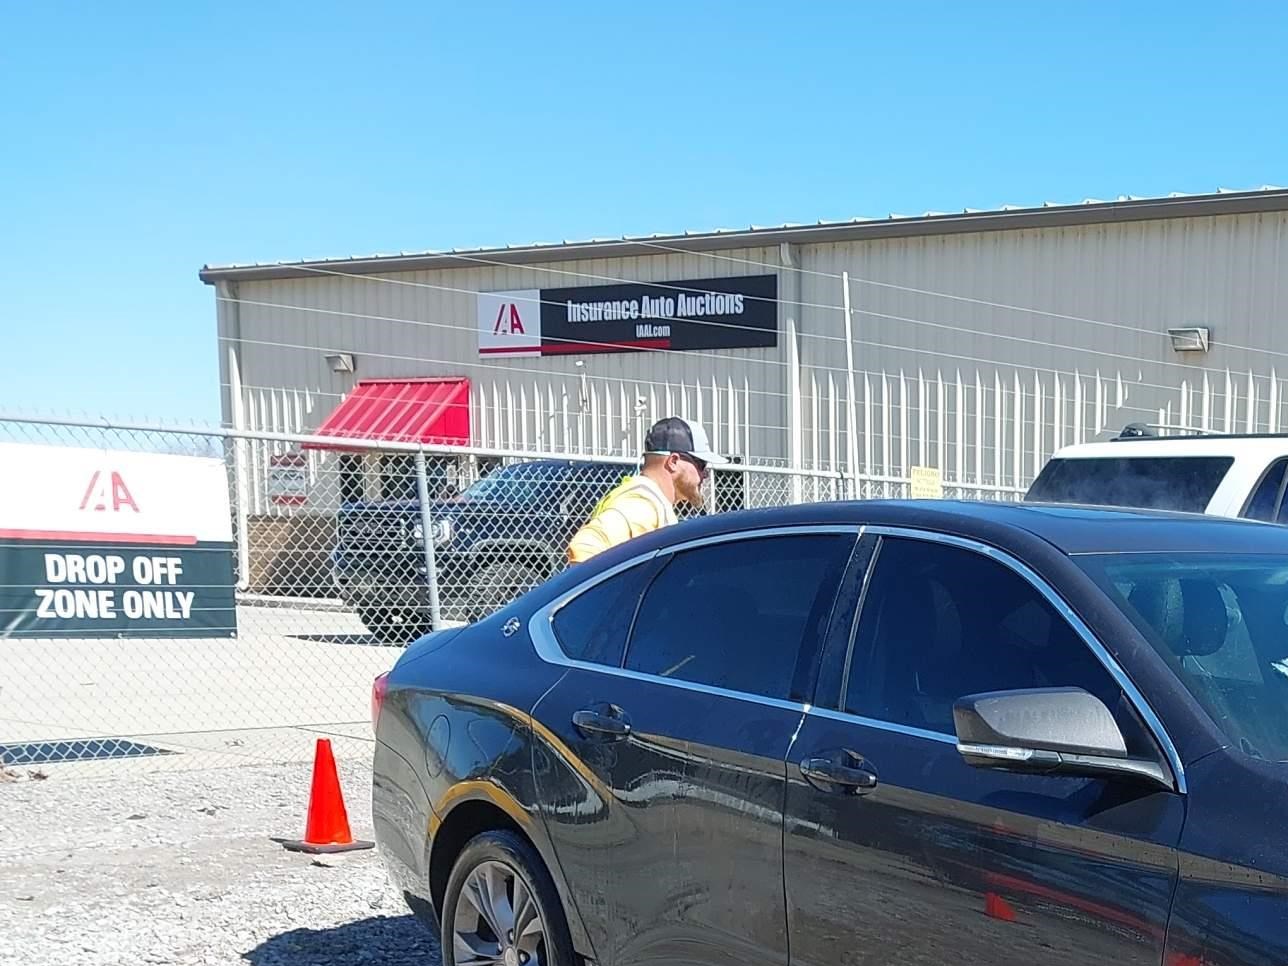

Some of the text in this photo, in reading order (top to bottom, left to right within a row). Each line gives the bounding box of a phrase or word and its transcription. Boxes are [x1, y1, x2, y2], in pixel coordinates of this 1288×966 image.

[567, 291, 744, 323] Insurance Auto Auctions
[44, 553, 183, 585] DROP OFF
[34, 588, 195, 619] ZONE ONLY
